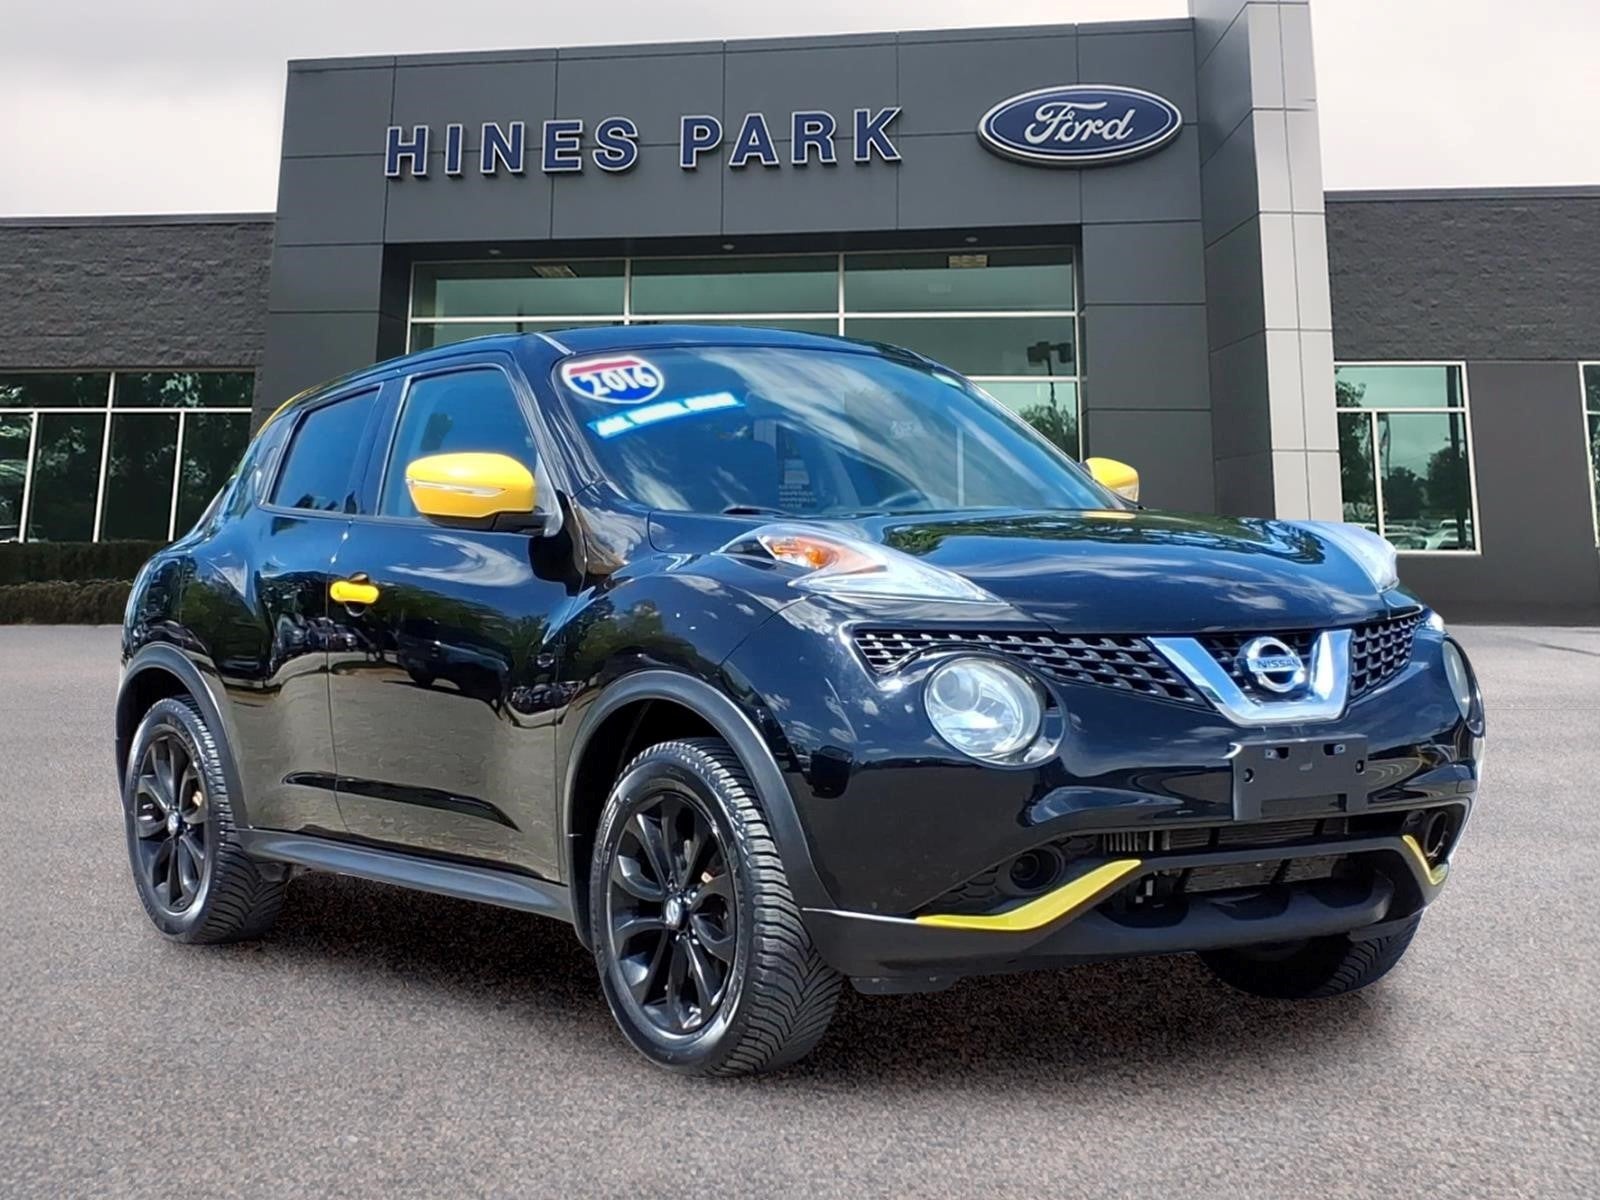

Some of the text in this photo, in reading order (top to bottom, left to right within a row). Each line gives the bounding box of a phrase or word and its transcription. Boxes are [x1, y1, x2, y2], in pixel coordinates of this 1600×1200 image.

[384, 107, 902, 176] HINES PARK
[1024, 101, 1136, 144] Ford
[580, 366, 657, 397] 2016
